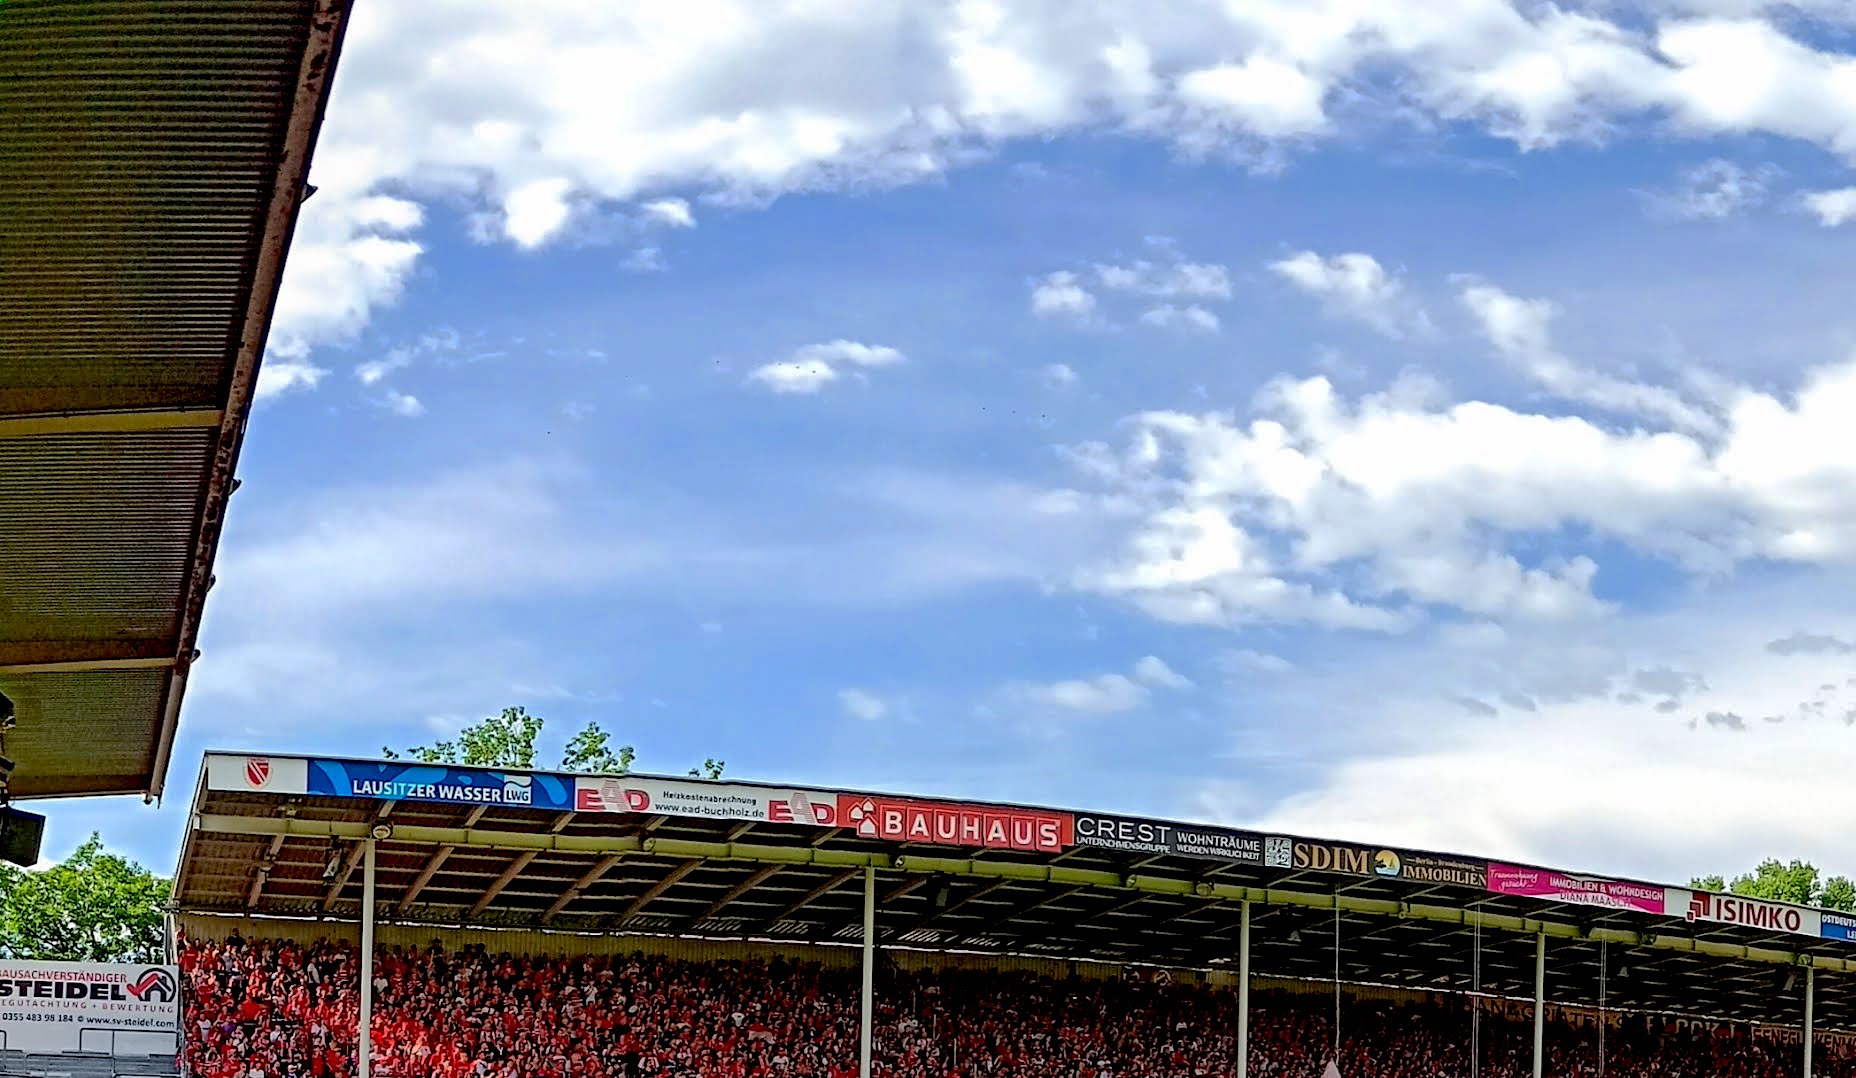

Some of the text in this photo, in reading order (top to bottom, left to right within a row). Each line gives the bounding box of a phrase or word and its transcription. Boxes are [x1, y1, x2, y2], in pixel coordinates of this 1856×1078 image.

[353, 780, 501, 803] LAUSITZER WASSER
[577, 780, 650, 812] EAD
[768, 792, 835, 824] EAD
[885, 810, 1058, 847] BAUHAUS
[1077, 817, 1171, 843] CREST
[1176, 831, 1260, 851] WOHNTRÄUME
[1293, 842, 1370, 875] SDIM
[1403, 865, 1487, 886] IMMOBILIEN
[1550, 876, 1663, 901] IMMOBILIEN & WOHNDESIGN
[1716, 899, 1800, 931] ISIMKO
[0, 979, 126, 1001] STEIDEL
[3, 1012, 175, 1028] 0355 483 98 184 www.sv-steidel.com
[102, 1003, 174, 1014] BEWERTUNG
